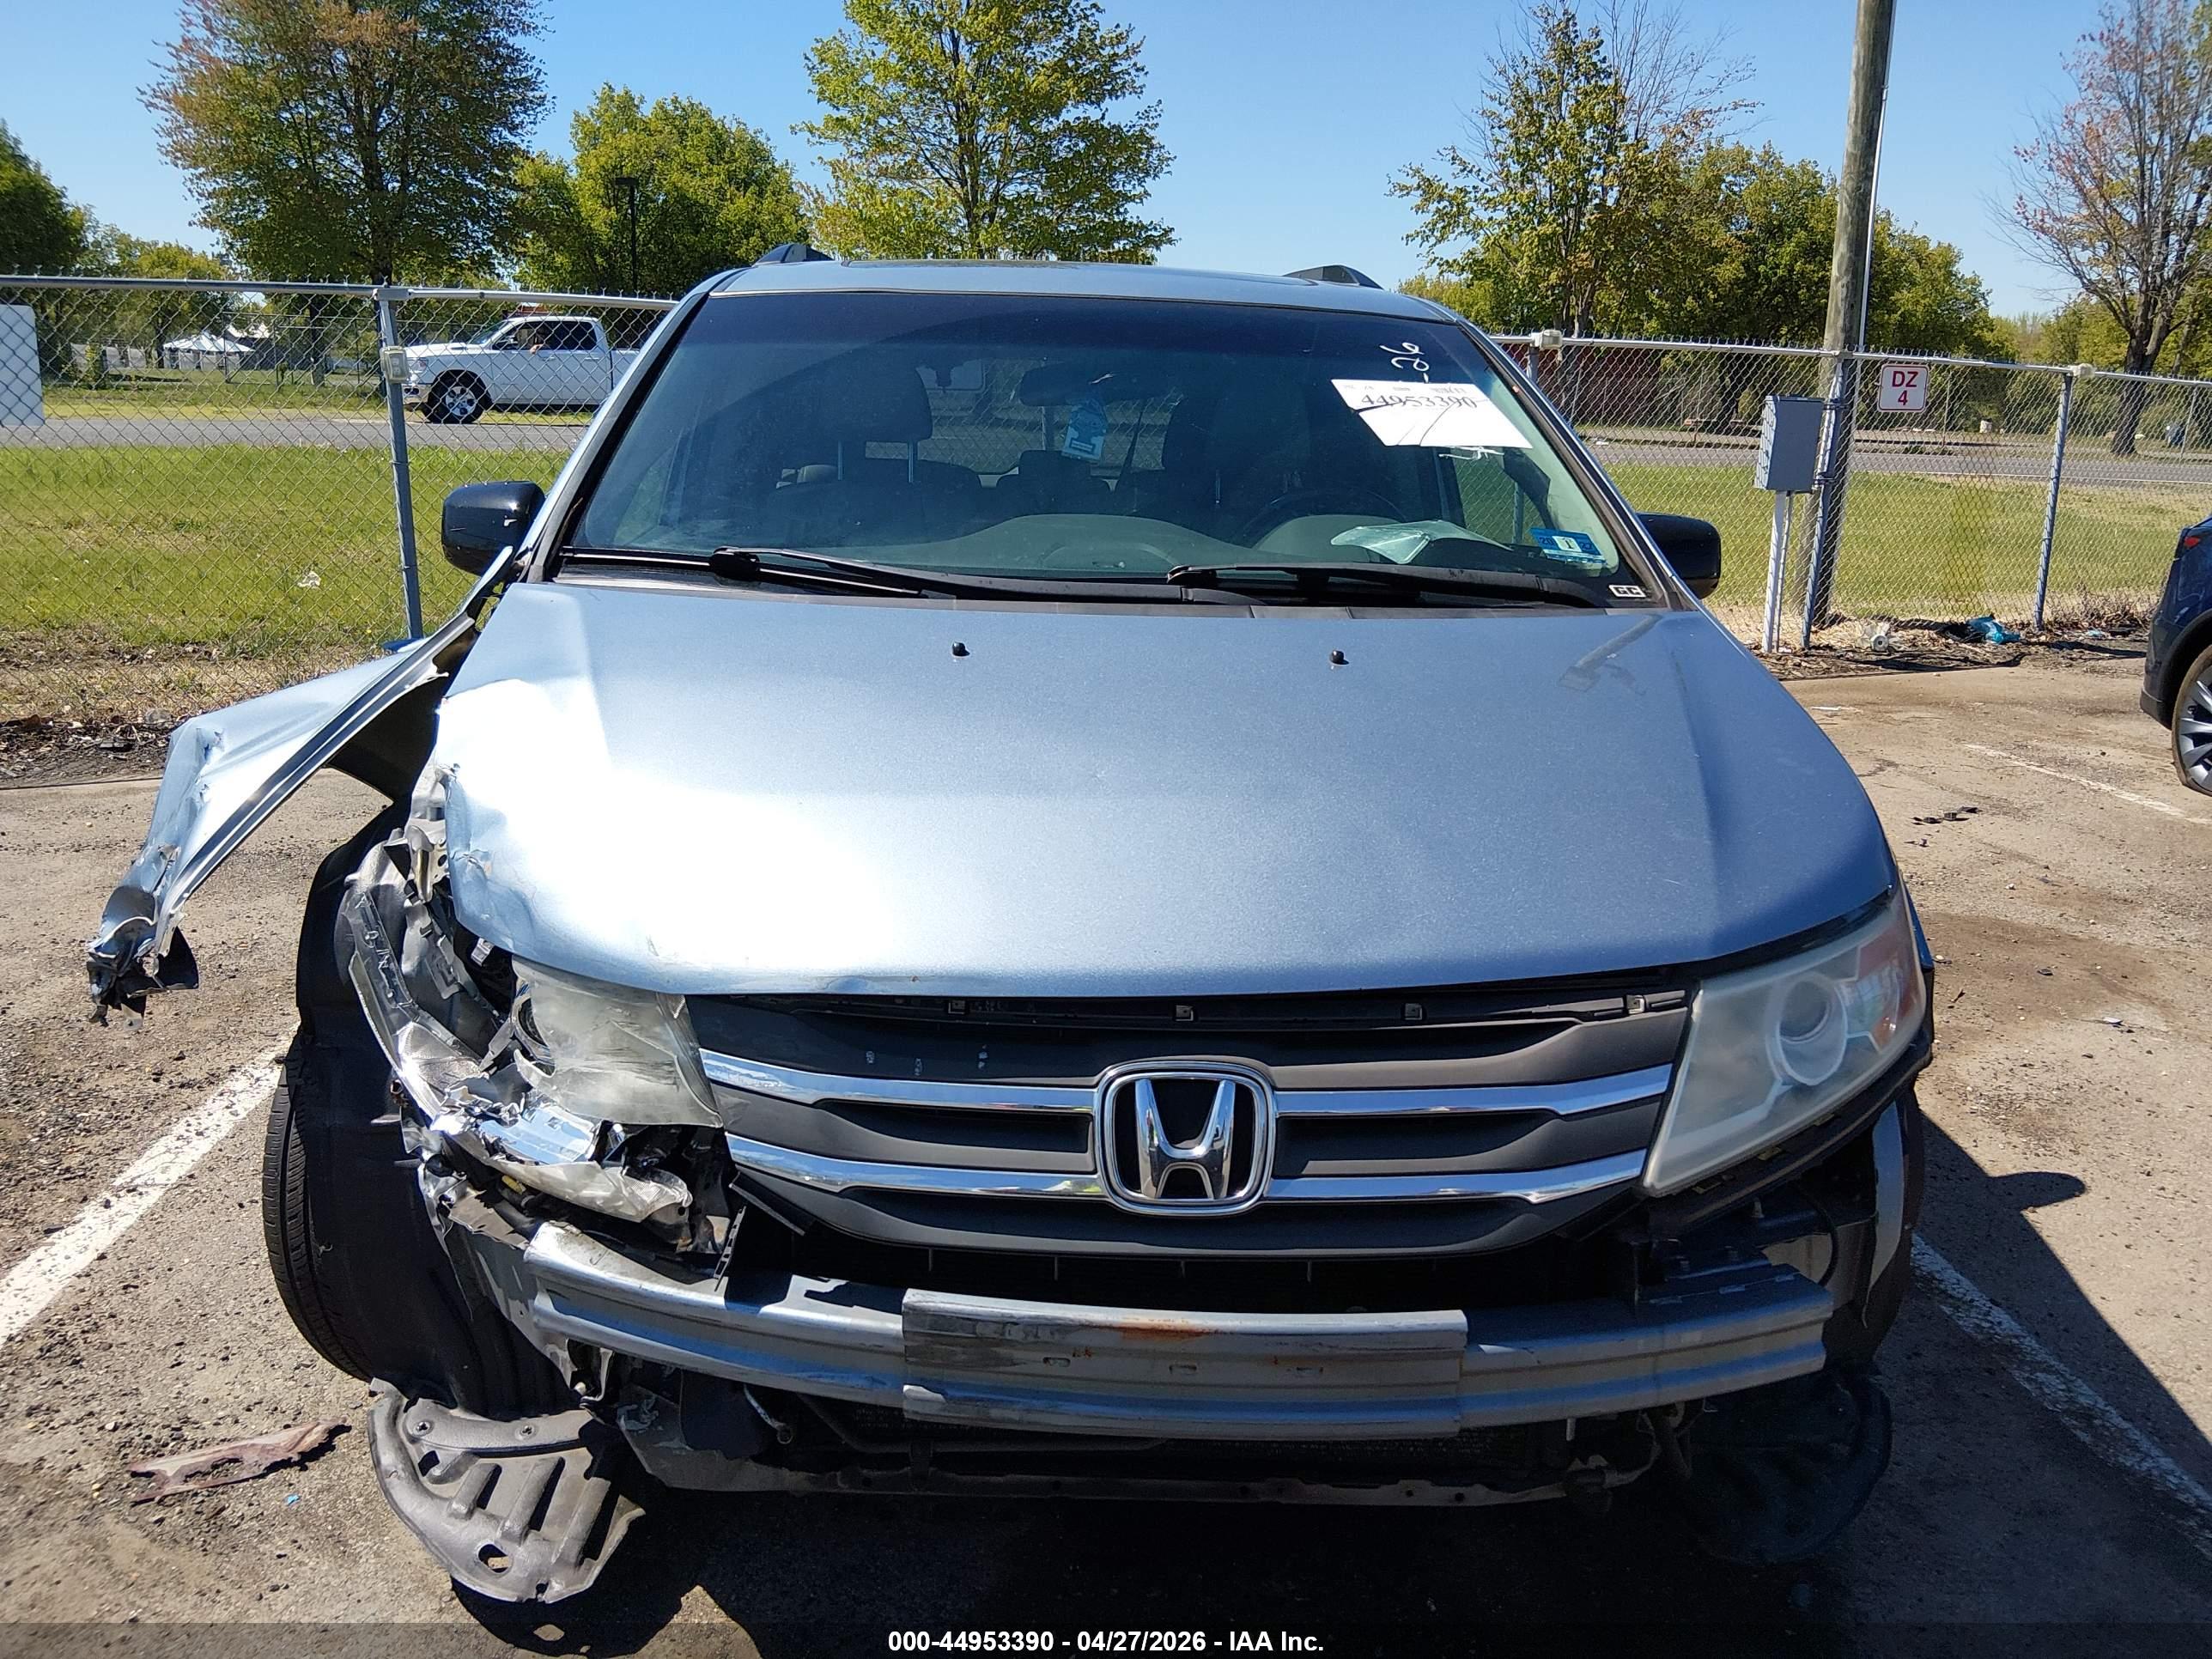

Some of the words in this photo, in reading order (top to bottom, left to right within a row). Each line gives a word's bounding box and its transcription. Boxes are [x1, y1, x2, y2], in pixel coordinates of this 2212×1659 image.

[1892, 370, 1918, 387] DZ
[1361, 393, 1479, 409] 44953390
[1898, 390, 1908, 406] 4
[1562, 537, 1575, 550] 1
